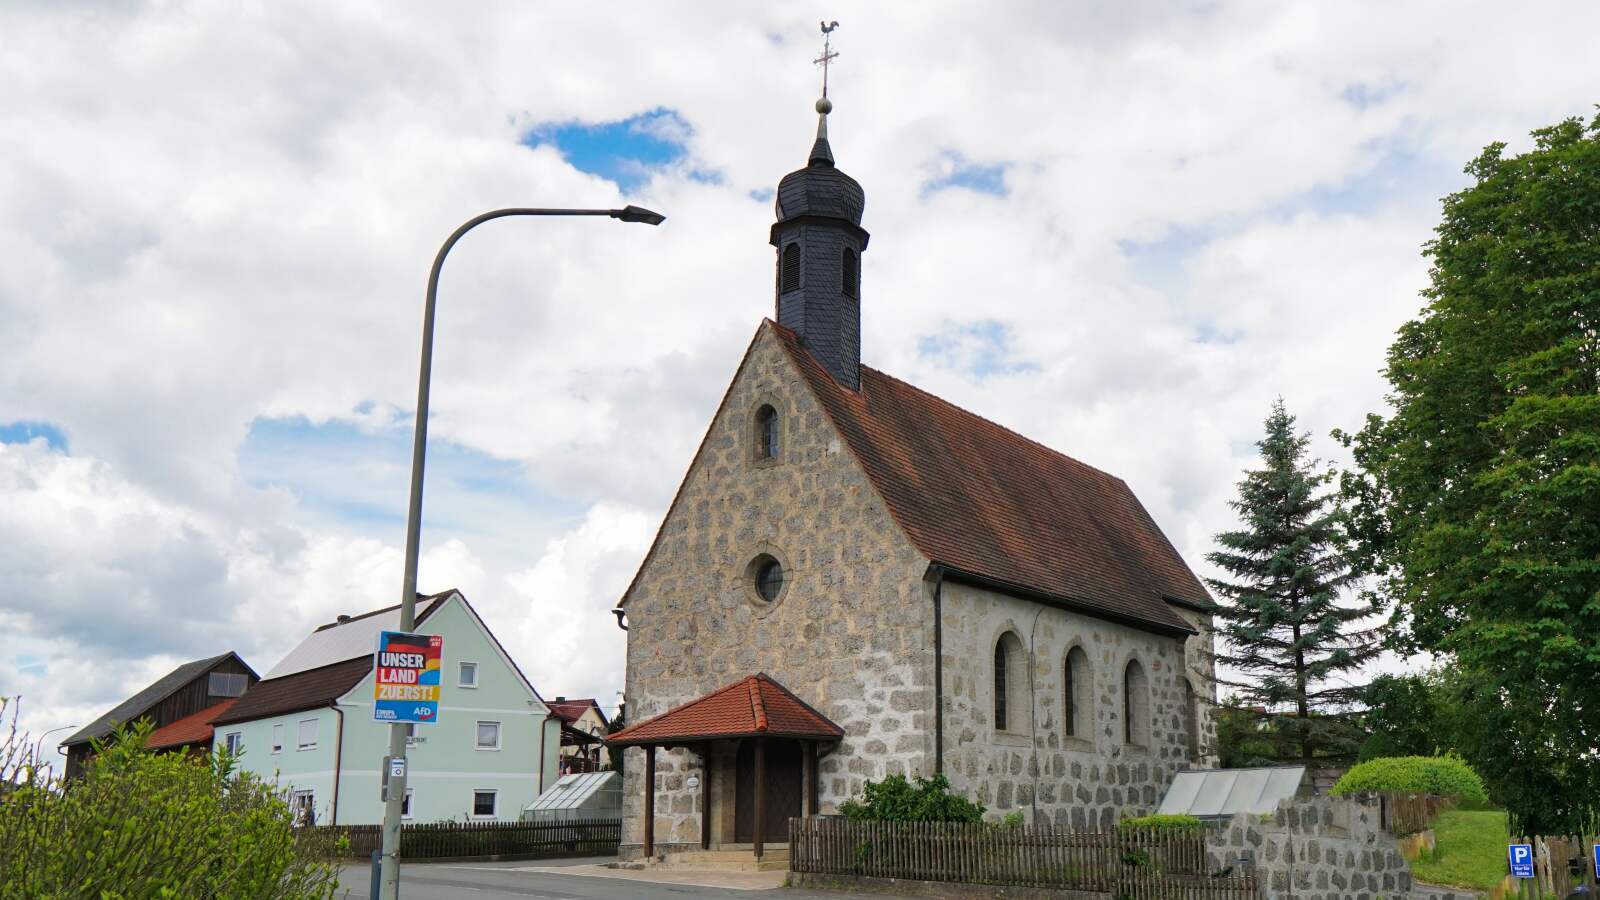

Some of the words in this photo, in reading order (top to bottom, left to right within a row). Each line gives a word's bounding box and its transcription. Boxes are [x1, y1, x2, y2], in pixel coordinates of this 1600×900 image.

[381, 652, 424, 668] UNSER
[380, 668, 416, 684] LAND
[379, 684, 433, 700] ZUERST!
[413, 706, 431, 716] AfD
[1515, 847, 1527, 863] P
